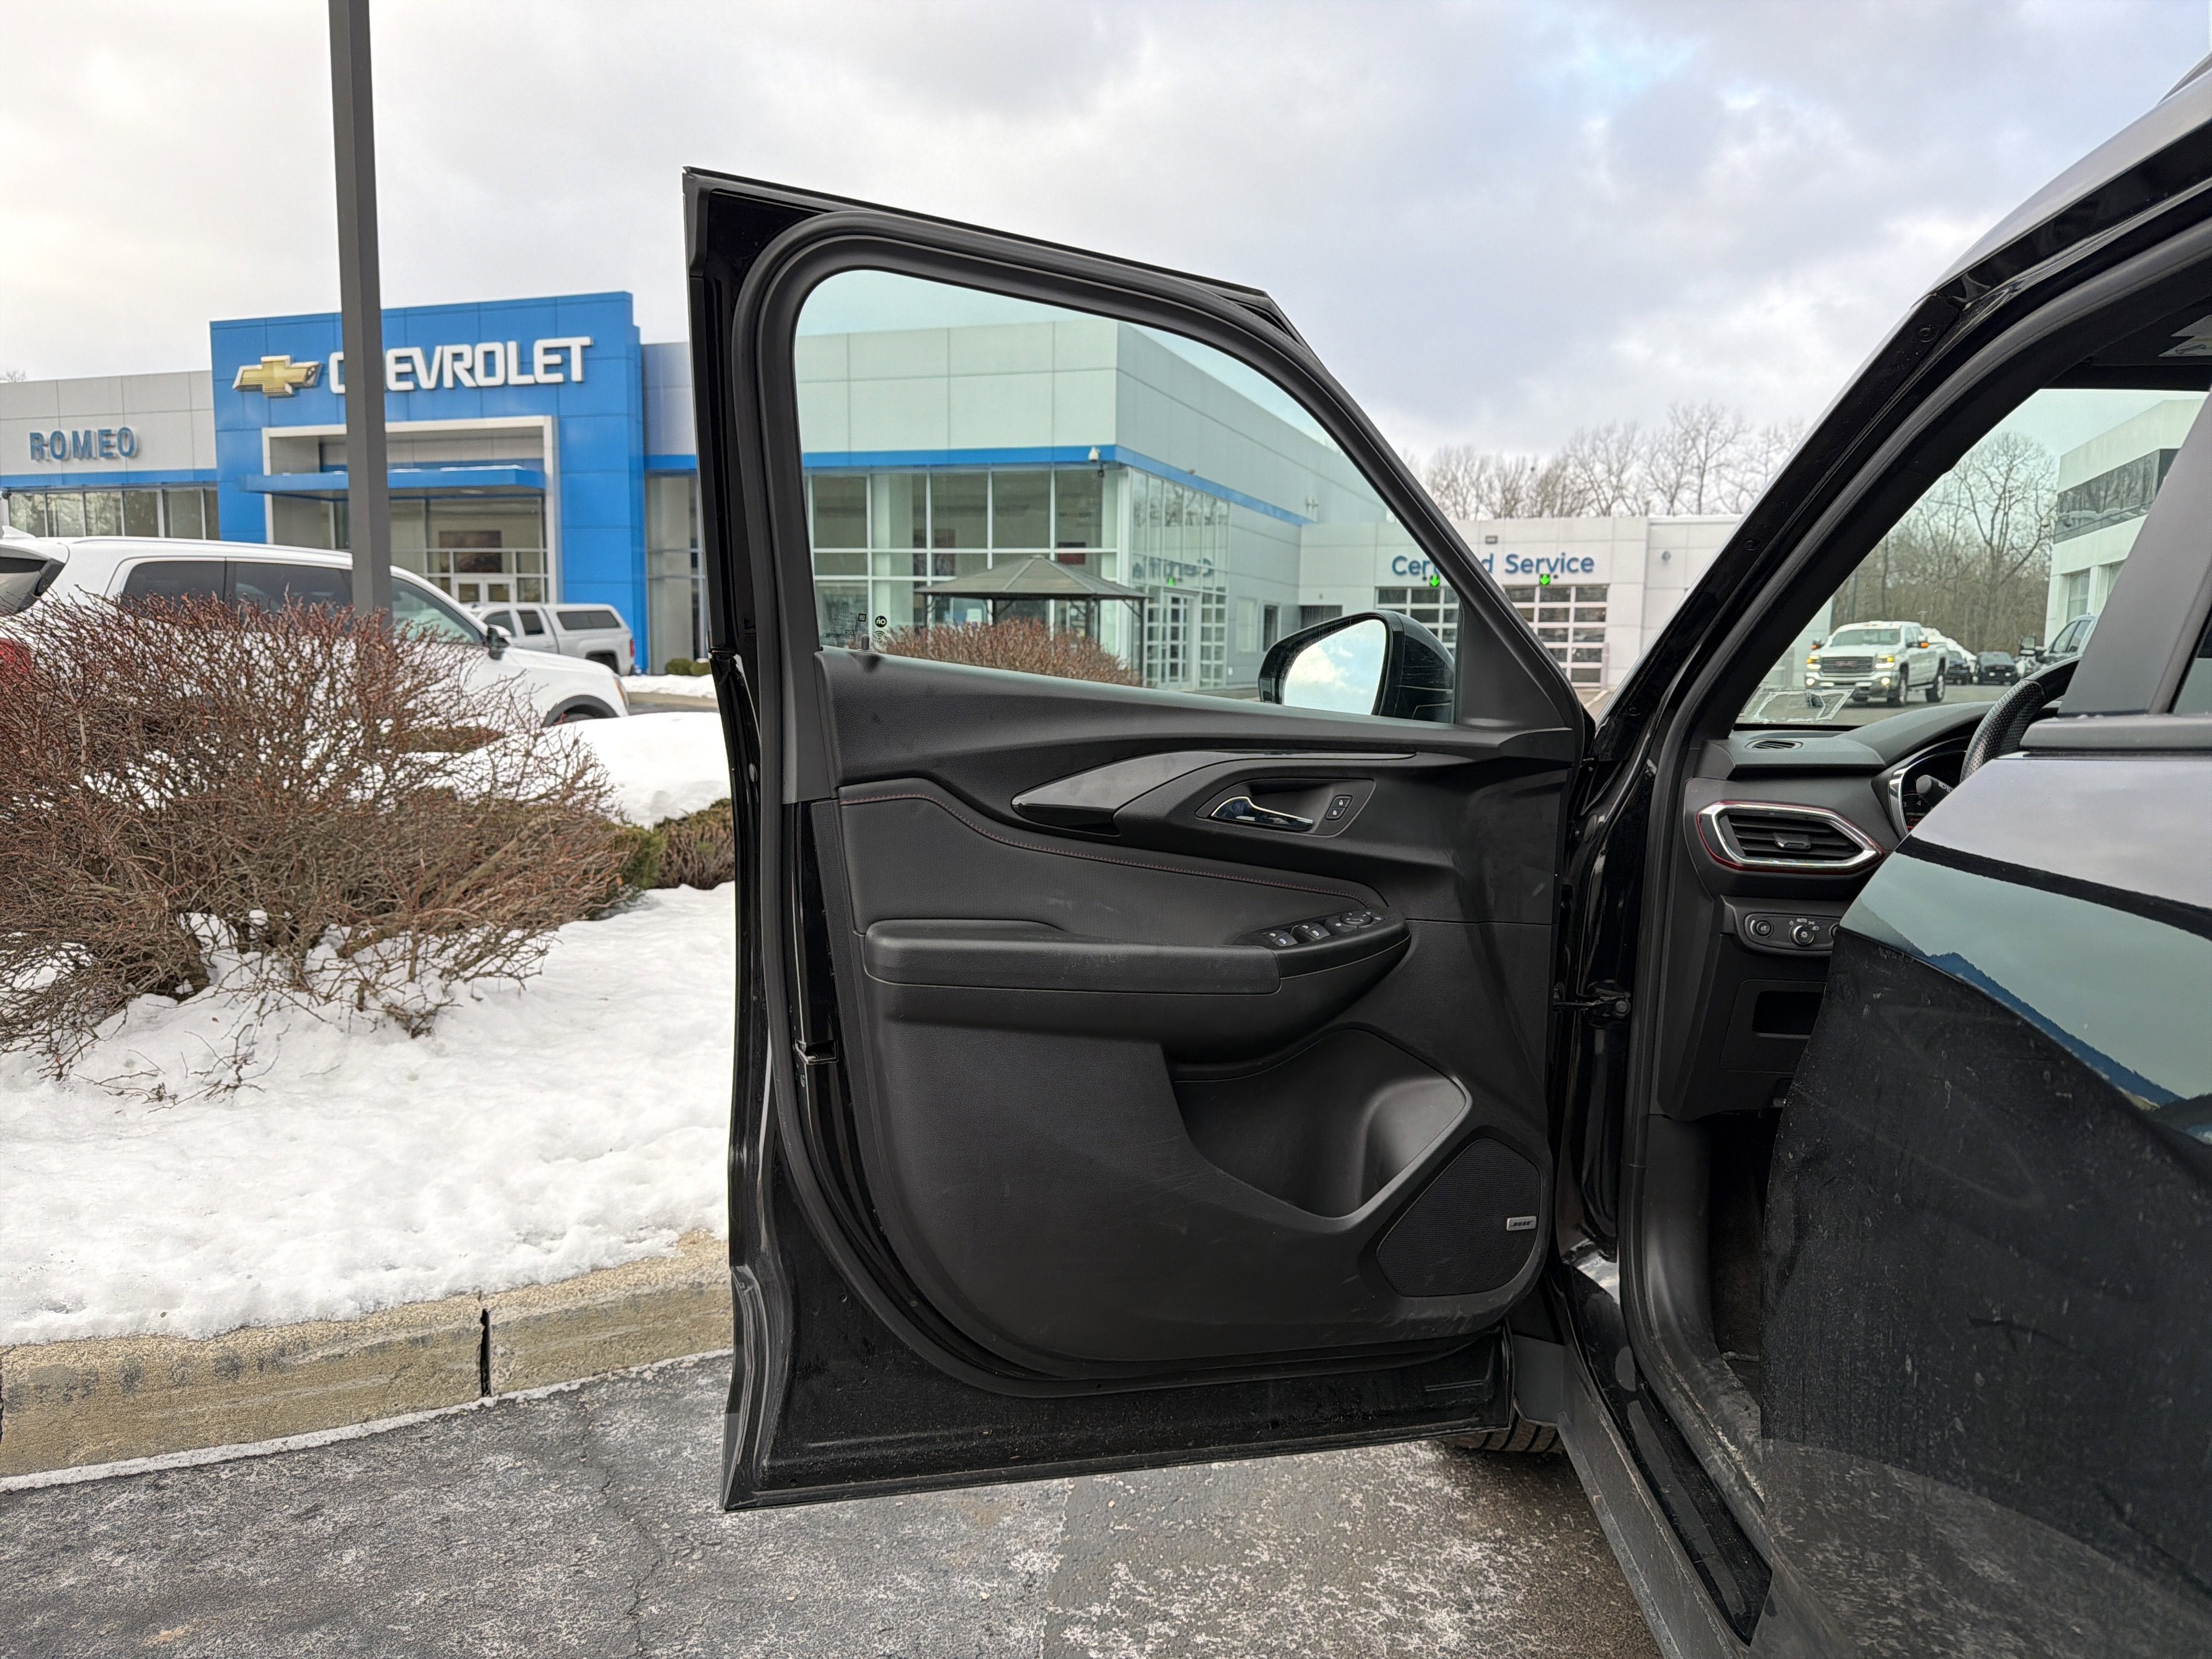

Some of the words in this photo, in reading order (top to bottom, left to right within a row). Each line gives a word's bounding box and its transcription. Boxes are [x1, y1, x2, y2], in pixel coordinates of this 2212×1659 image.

[329, 336, 592, 394] CEVROLET
[29, 426, 136, 461] ROMEO
[1504, 552, 1595, 574] Service
